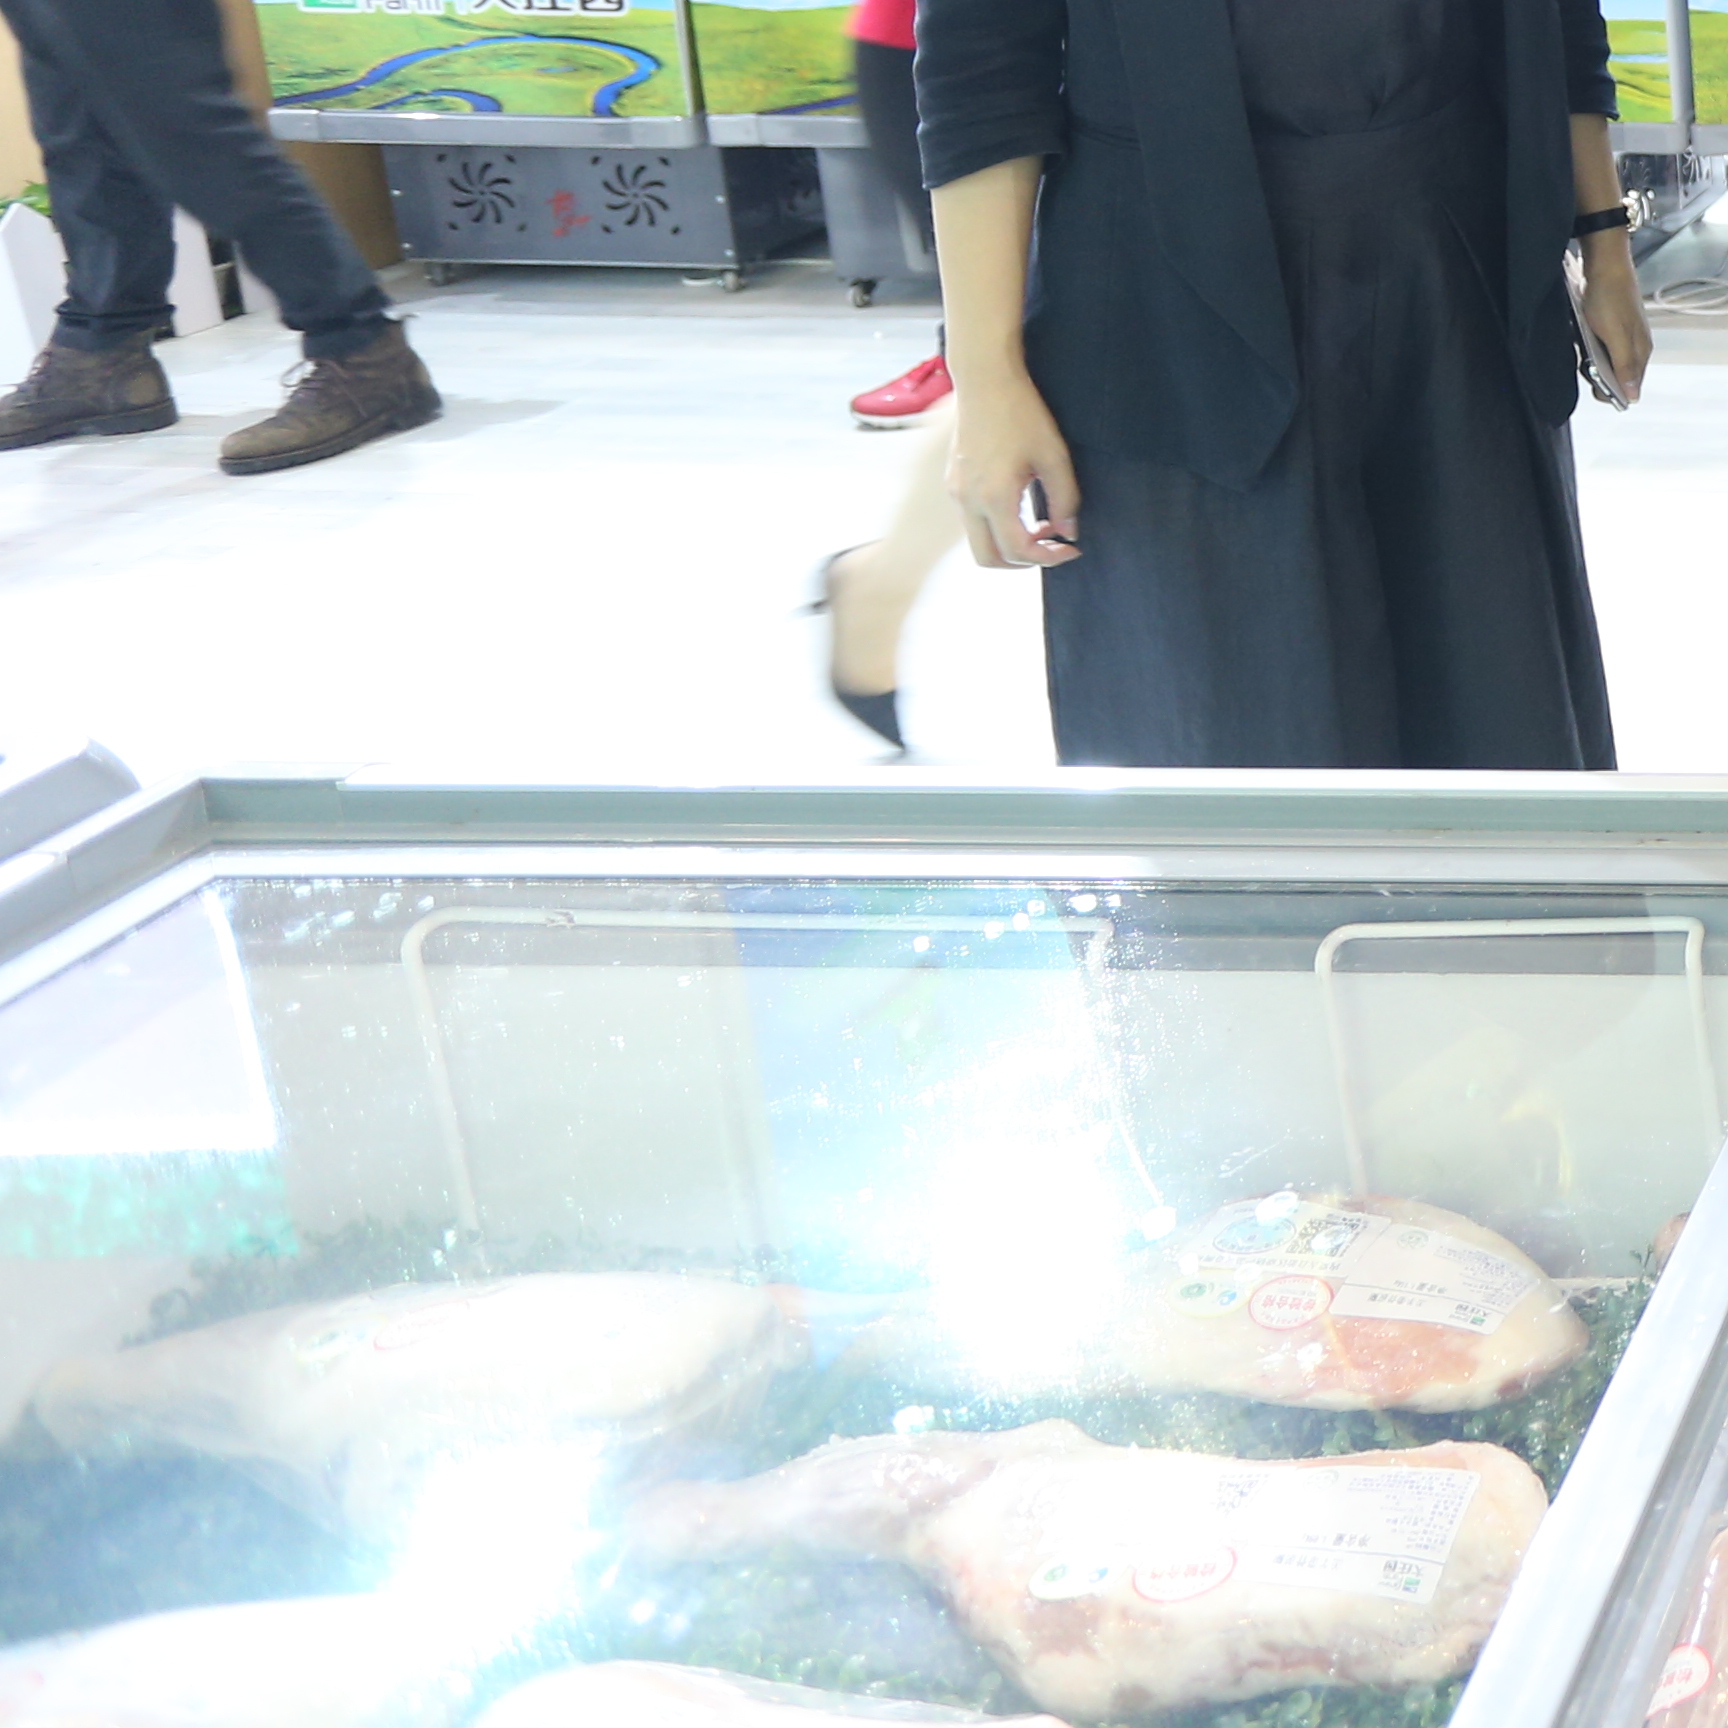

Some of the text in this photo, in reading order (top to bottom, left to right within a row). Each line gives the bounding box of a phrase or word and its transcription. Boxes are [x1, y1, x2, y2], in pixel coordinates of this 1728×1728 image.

[1416, 1281, 1448, 1295] 净含量
[1260, 1293, 1317, 1313] 检验合格
[1332, 1533, 1370, 1548] 净含量
[1383, 1559, 1424, 1577] 大庄园
